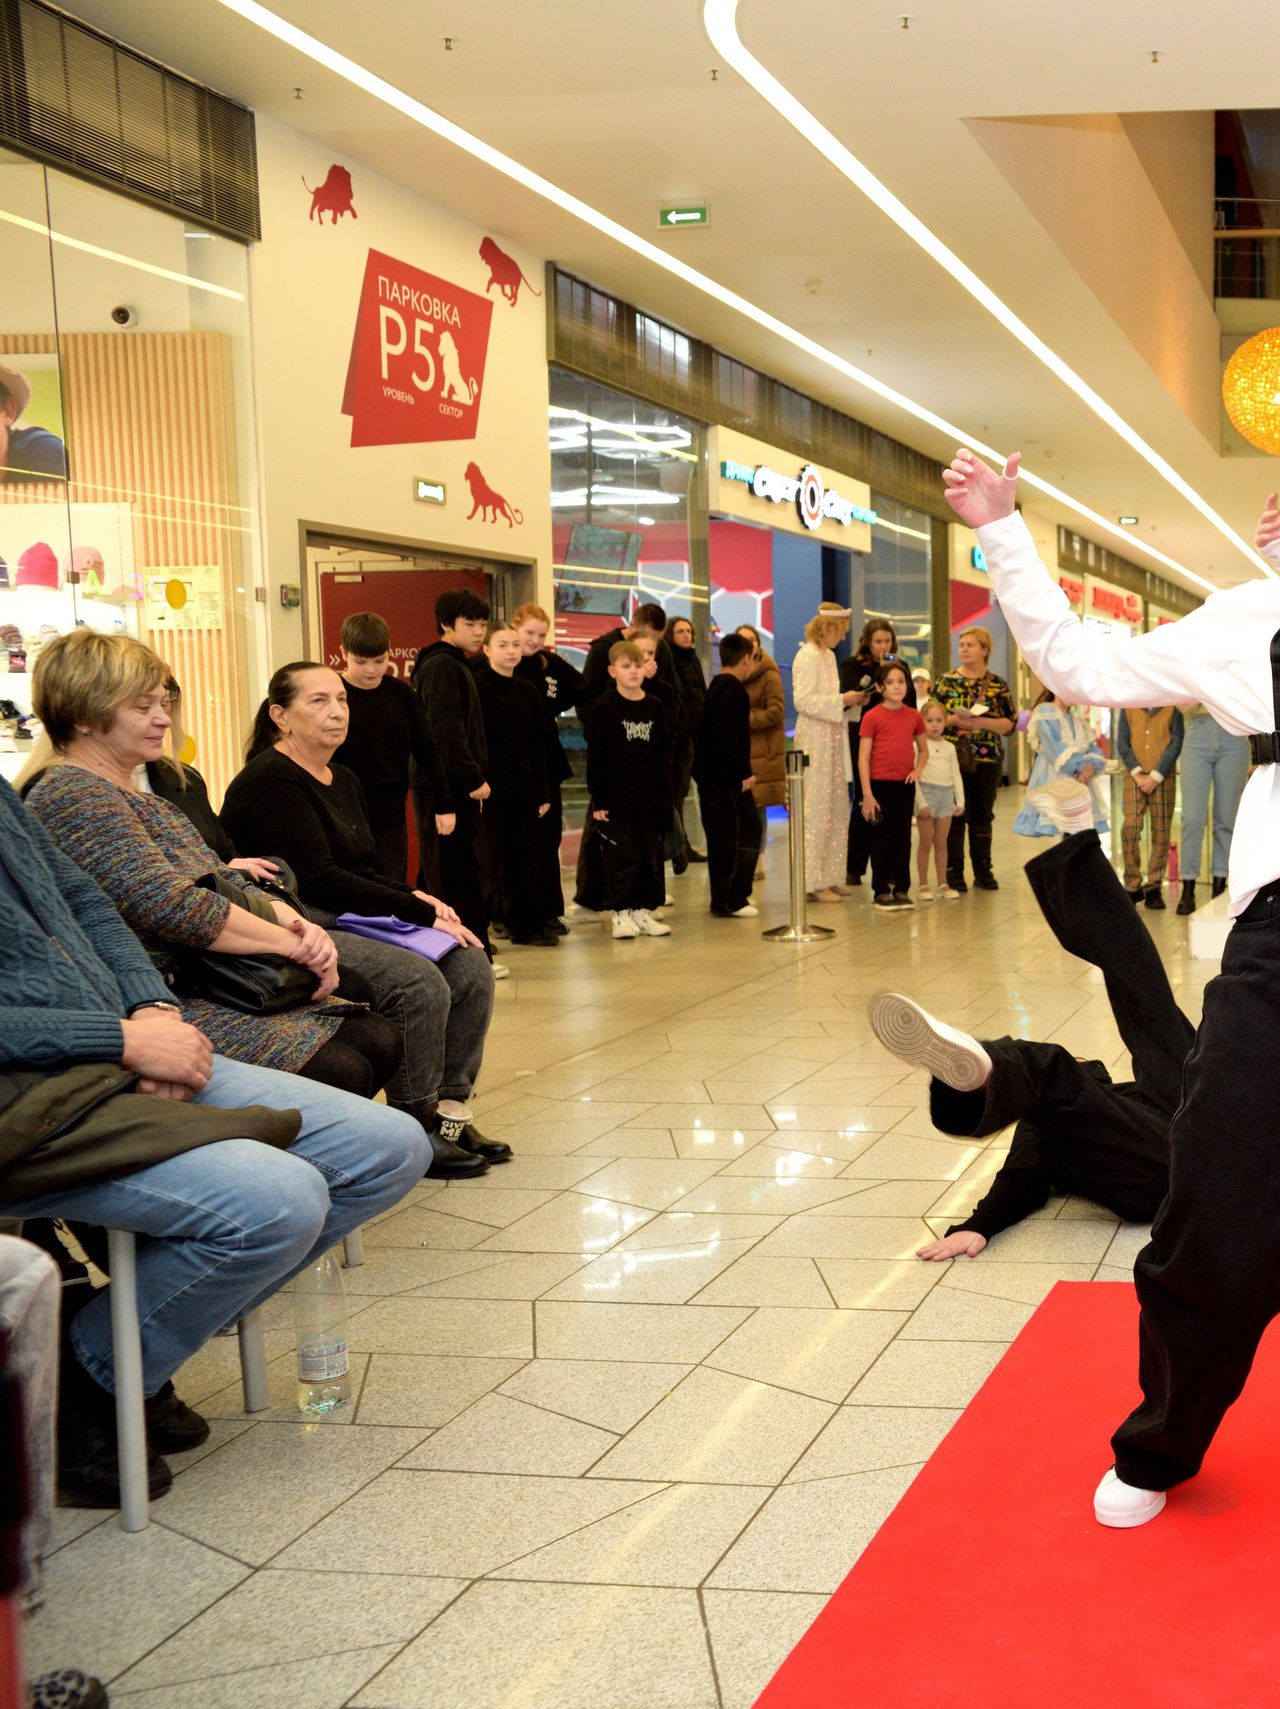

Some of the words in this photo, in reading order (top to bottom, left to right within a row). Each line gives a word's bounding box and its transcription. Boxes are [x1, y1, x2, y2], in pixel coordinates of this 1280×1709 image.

[378, 275, 461, 328] ПАРКОВКА
[382, 385, 415, 405] УРОВЕНЬ
[438, 403, 464, 419] СЕКТОР
